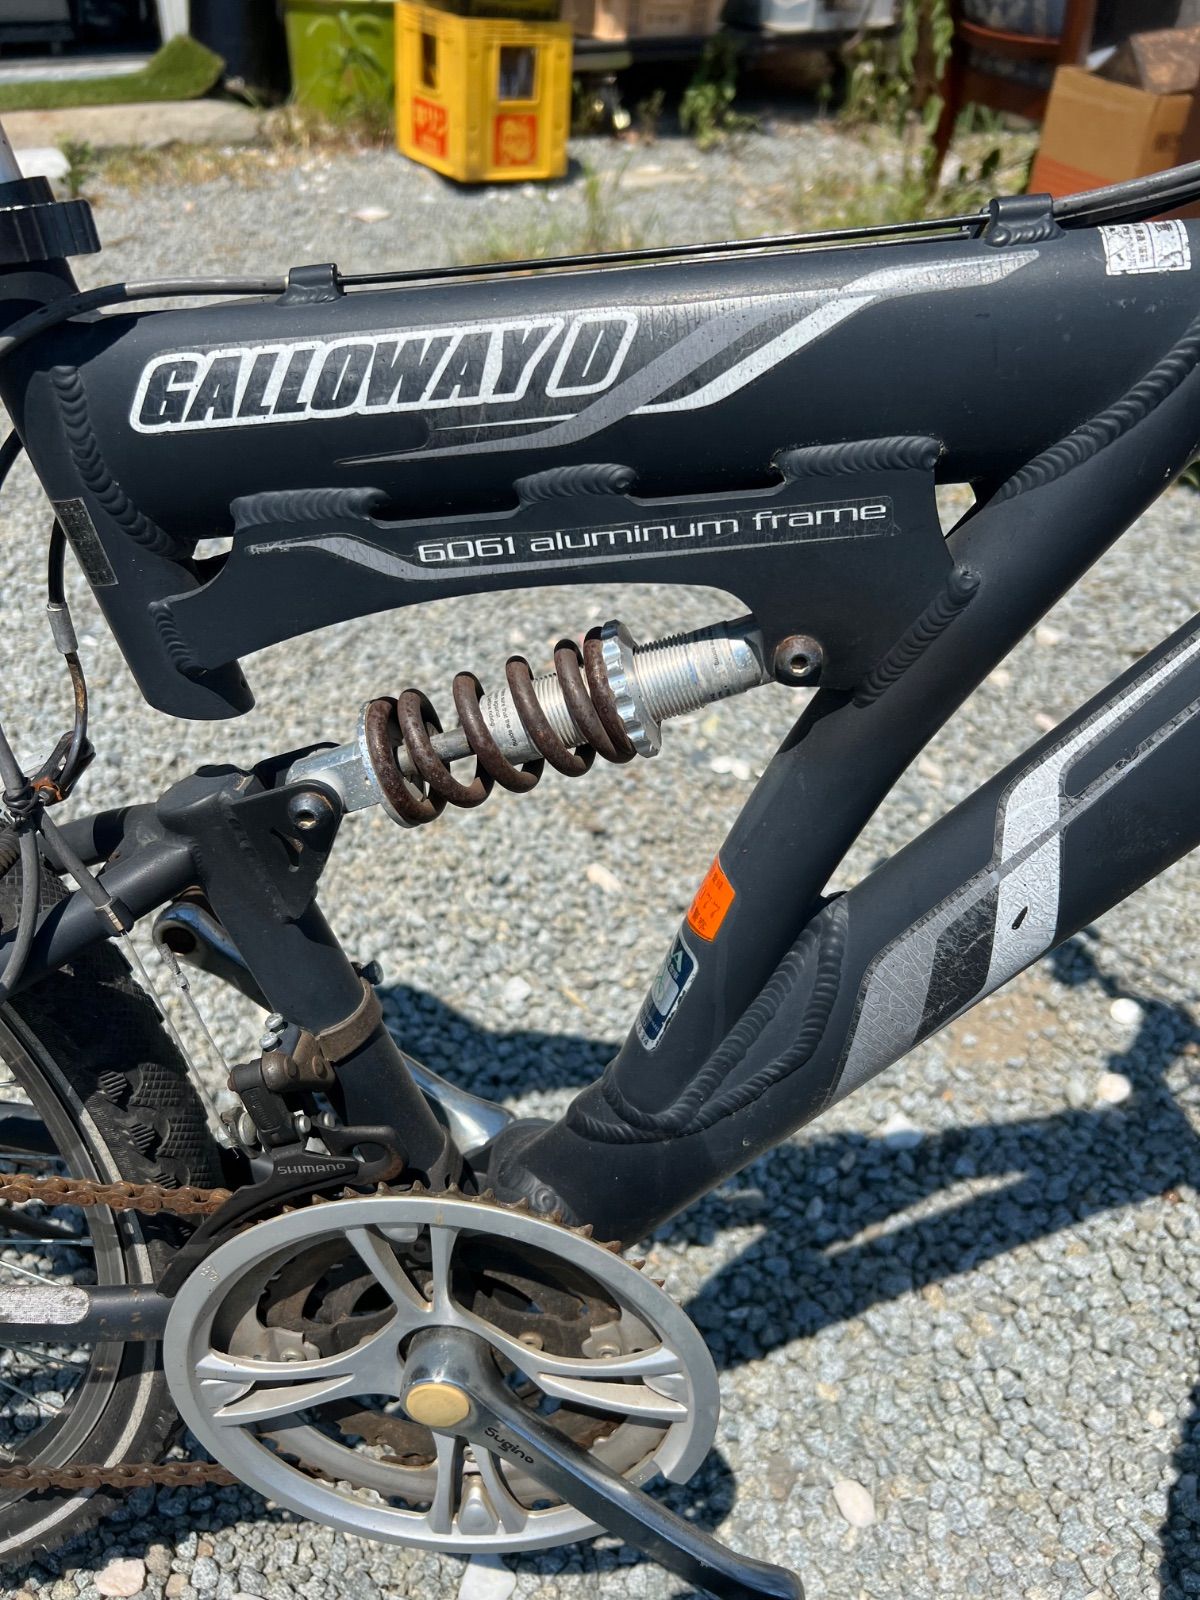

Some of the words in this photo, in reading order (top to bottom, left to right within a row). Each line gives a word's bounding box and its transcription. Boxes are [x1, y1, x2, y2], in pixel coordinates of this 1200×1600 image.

[417, 535, 516, 563] 6061
[529, 515, 739, 553] aluminum
[752, 500, 887, 532] frame
[508, 729, 518, 746] spring
[277, 1163, 346, 1175] SHIMANO
[484, 1426, 535, 1465] Sugino
